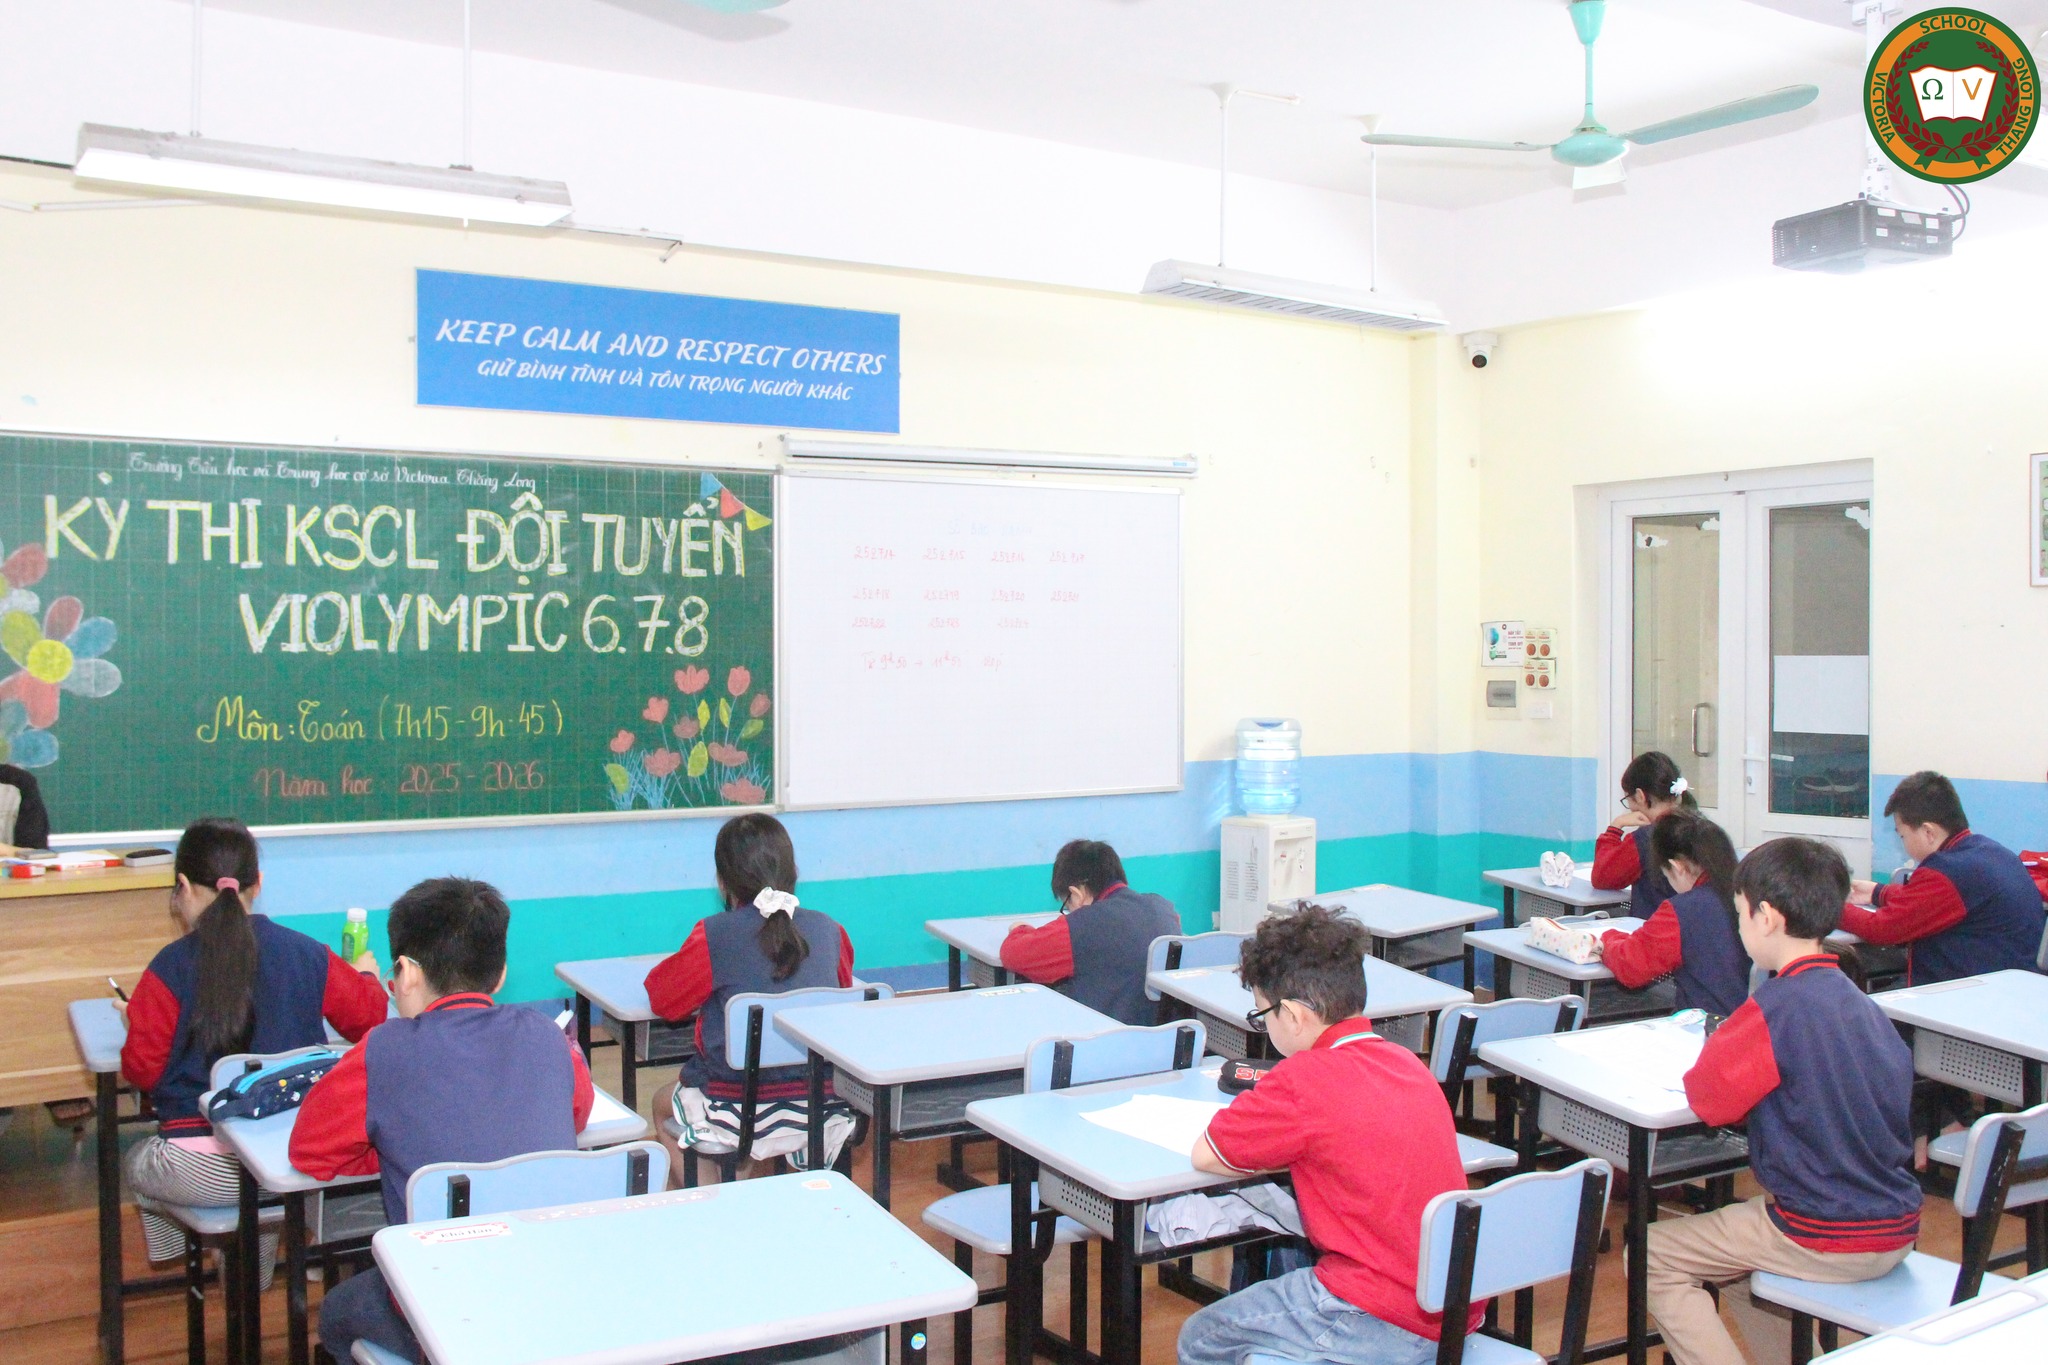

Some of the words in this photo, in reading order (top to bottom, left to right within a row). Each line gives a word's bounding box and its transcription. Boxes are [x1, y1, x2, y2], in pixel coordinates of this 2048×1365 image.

[435, 318, 517, 347] KEEP
[522, 325, 602, 353] CALM
[606, 333, 669, 358] AND
[676, 338, 791, 368] RESPECT
[791, 348, 887, 375] OTHERS
[477, 357, 517, 377] GIỮ
[516, 359, 568, 381] BÌNH
[571, 363, 616, 384] TĨNH
[649, 370, 686, 388] TÔN
[689, 374, 747, 395] TRỌNG
[748, 378, 804, 397] NGƯỜI
[806, 382, 853, 400] KHÁC
[276, 461, 321, 487] Trung
[395, 466, 450, 484] Victoria
[456, 468, 498, 493] Thăng
[503, 472, 536, 493] Long
[146, 498, 263, 569] THI
[286, 504, 439, 570] KSCL
[456, 491, 570, 585] ĐỘI
[582, 496, 745, 578] TUYỂN
[239, 590, 570, 654] VIOLYMPIC
[298, 700, 366, 742] Toán
